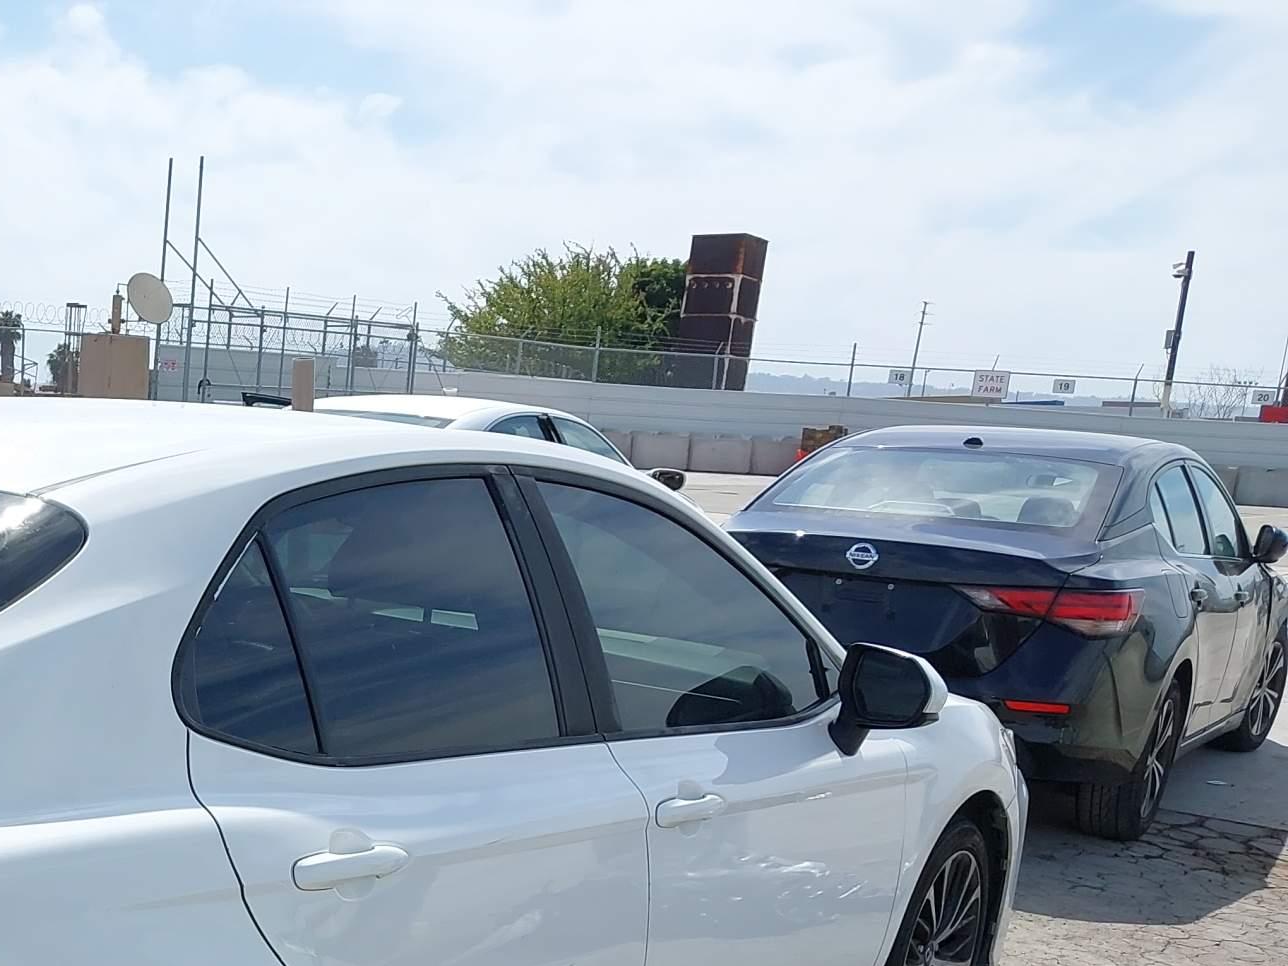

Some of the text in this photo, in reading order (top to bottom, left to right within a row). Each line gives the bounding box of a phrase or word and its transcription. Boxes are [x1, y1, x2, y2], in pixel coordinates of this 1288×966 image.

[895, 373, 905, 381] 18
[978, 374, 1005, 384] STATE
[977, 385, 1002, 393] FARM
[1059, 382, 1070, 391] 19
[1257, 393, 1270, 402] 20
